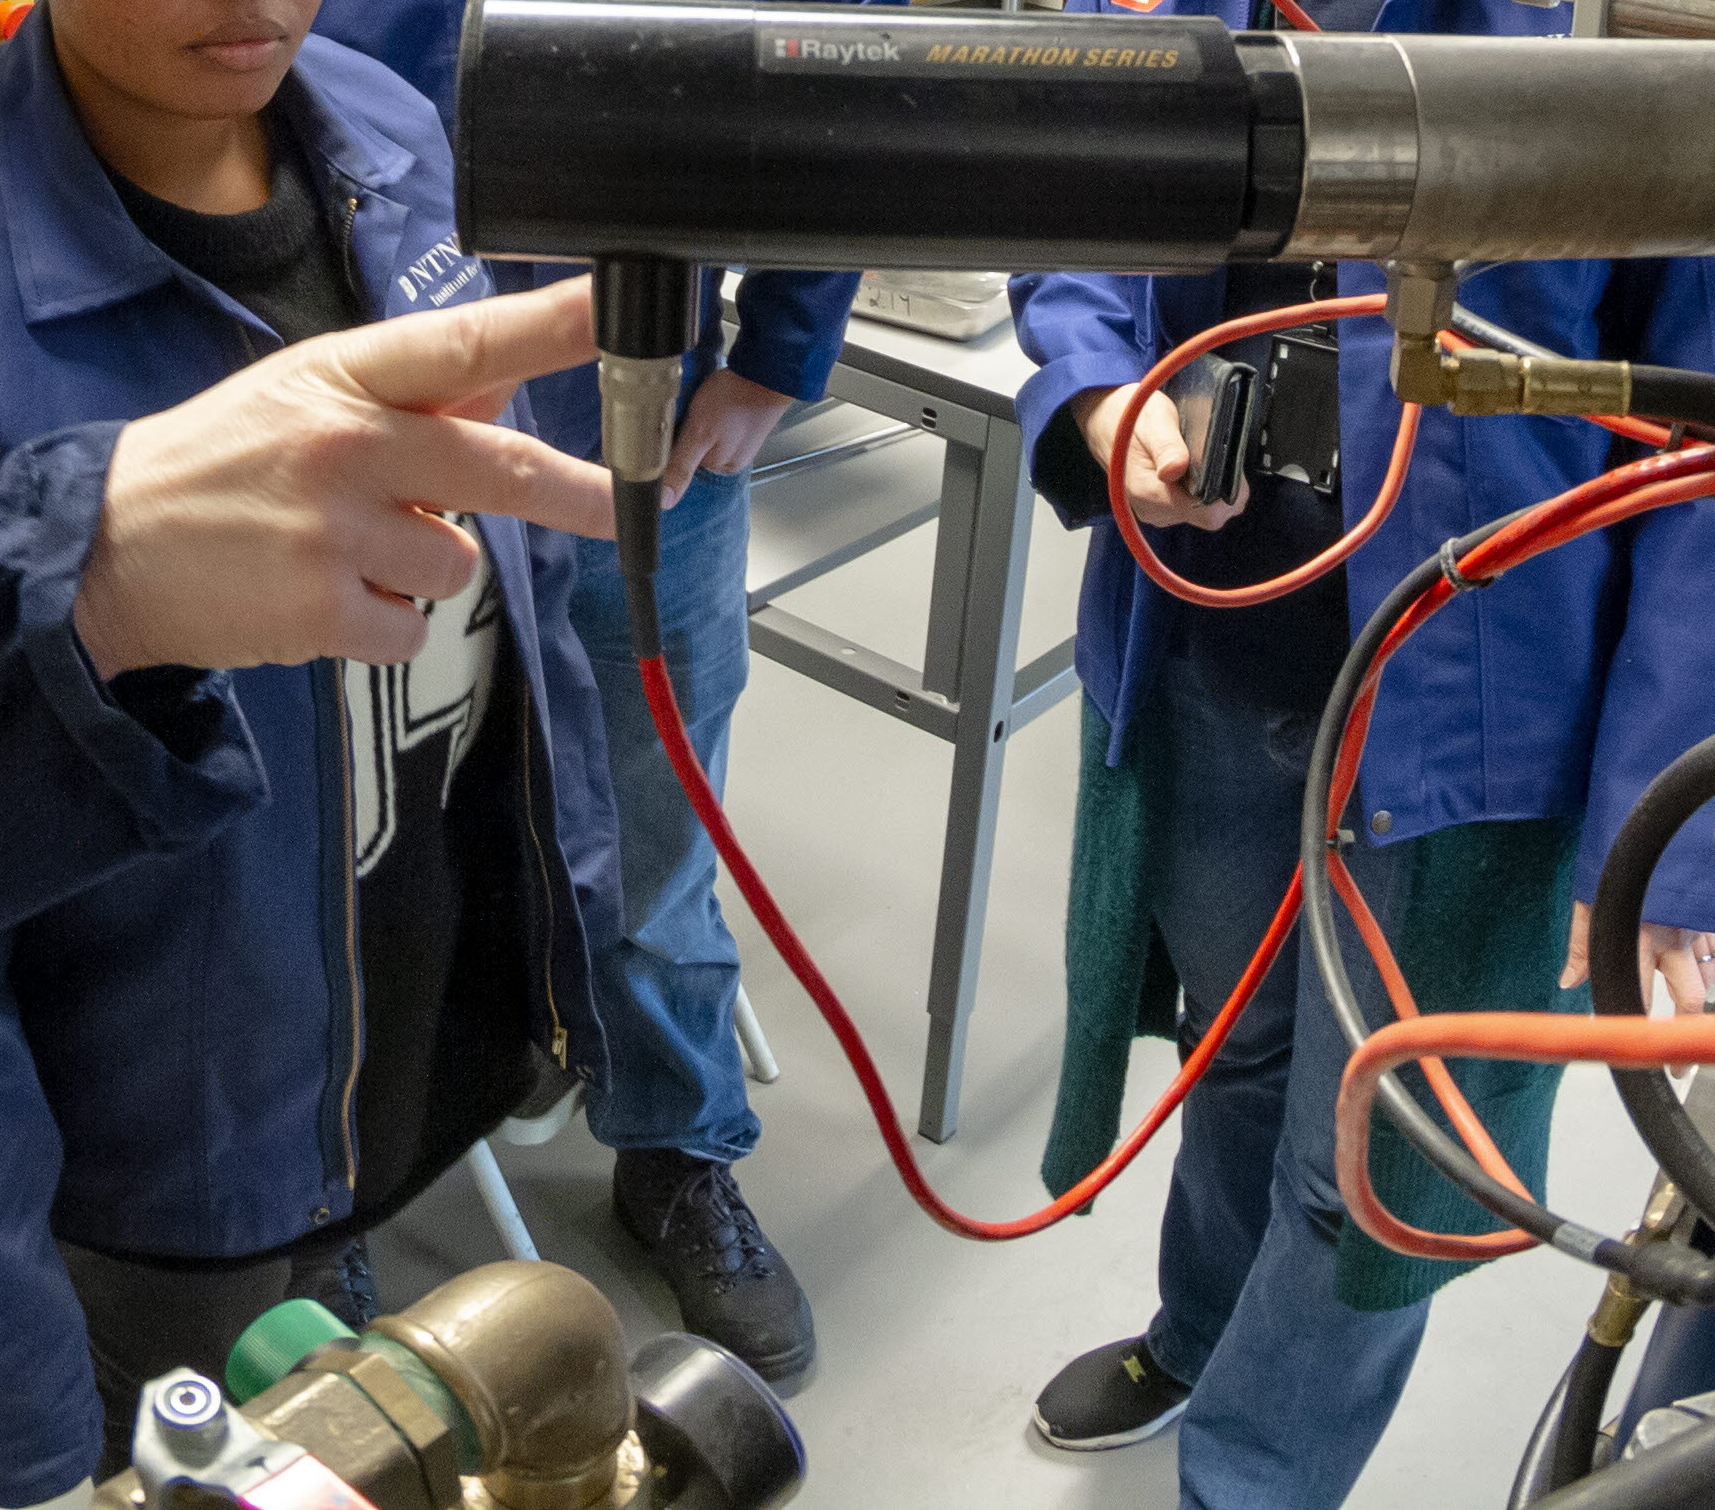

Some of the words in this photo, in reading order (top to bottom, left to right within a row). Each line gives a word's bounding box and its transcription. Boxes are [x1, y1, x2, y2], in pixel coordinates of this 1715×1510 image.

[801, 39, 900, 66] Raytek
[925, 44, 1080, 67] MARATHON
[1083, 48, 1180, 69] SERIES
[407, 232, 463, 291] NTN
